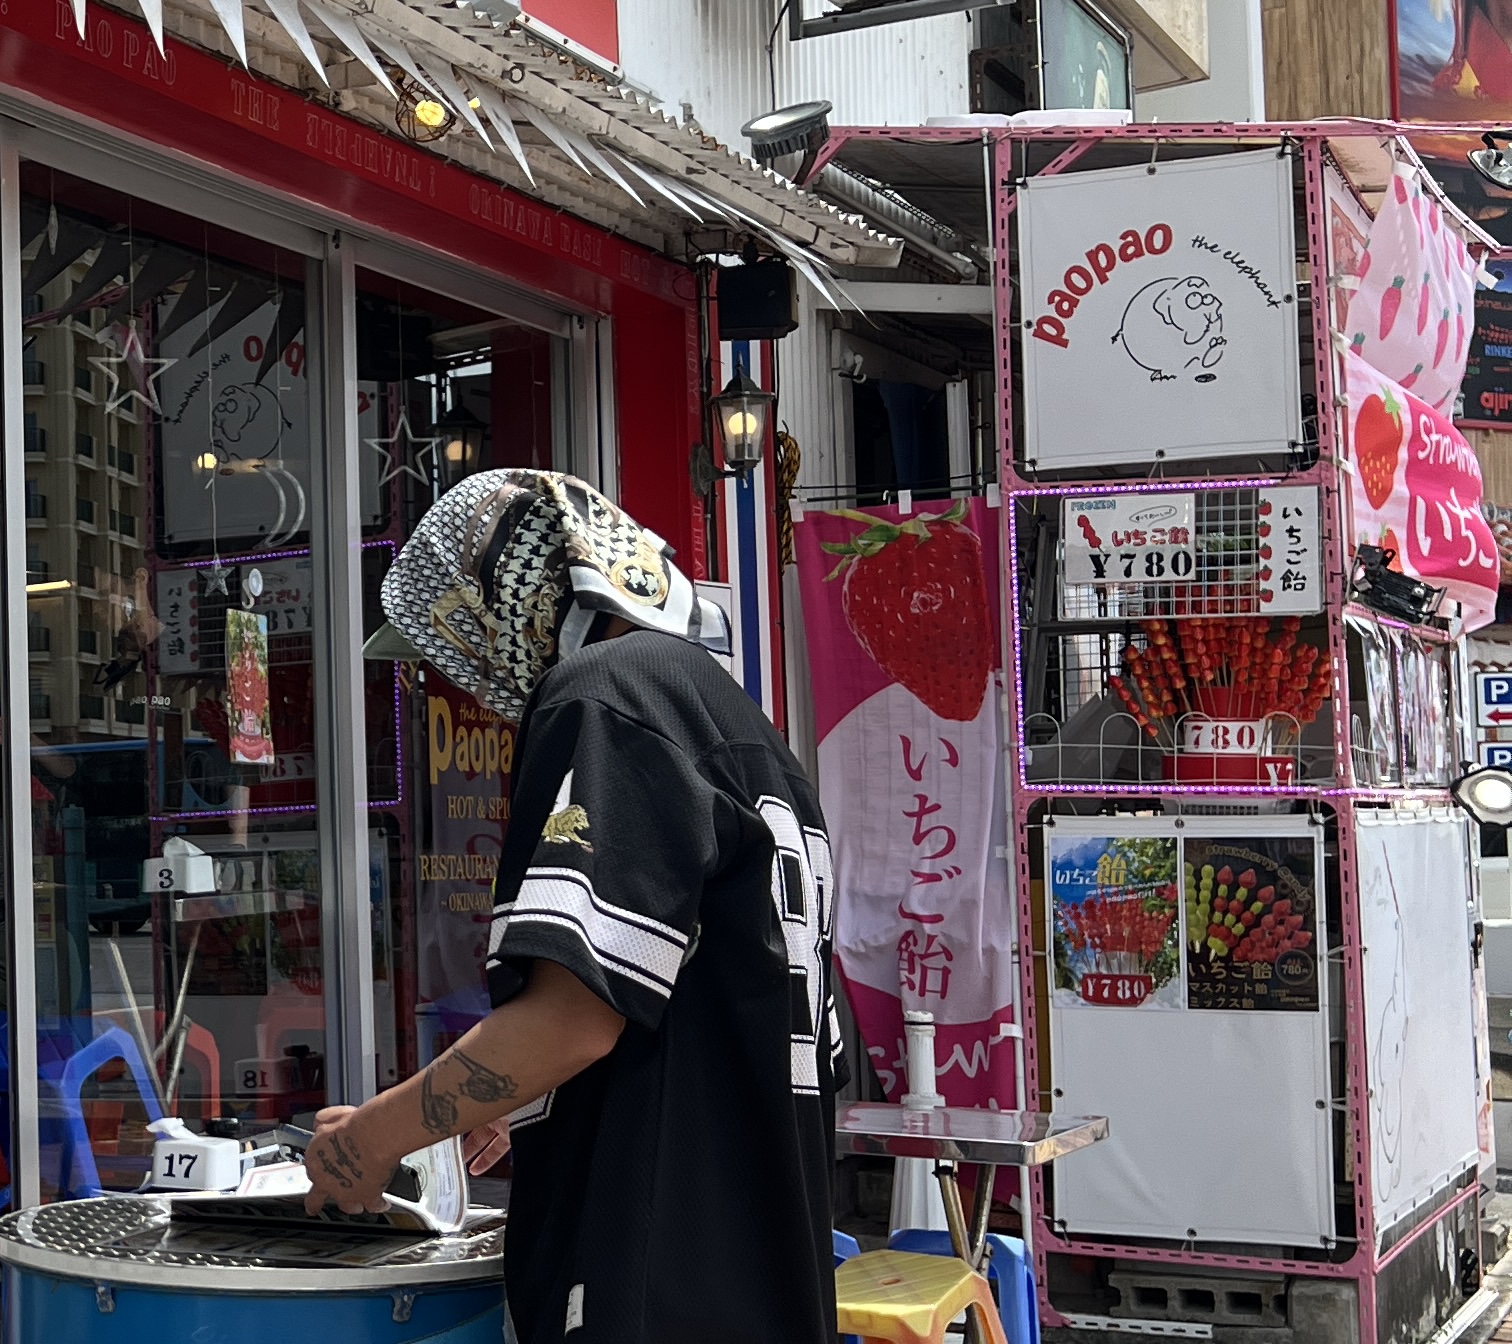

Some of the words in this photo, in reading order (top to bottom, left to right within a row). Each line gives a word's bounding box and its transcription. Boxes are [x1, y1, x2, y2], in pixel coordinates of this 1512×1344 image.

[1031, 222, 1174, 350] paopao
[1191, 234, 1222, 254] the
[1222, 249, 1280, 309] elephant
[1279, 506, 1308, 592] いちご飴
[1088, 550, 1192, 579] ¥780
[1490, 680, 1509, 703] P
[1191, 724, 1255, 750] 780
[447, 795, 474, 820] HOT
[476, 796, 486, 820] &
[157, 868, 175, 890] 3
[897, 733, 961, 1001] いちご飴
[1055, 852, 1127, 886] いちご飴
[1188, 961, 1273, 980] いちご飴
[162, 1152, 199, 1179] 17
